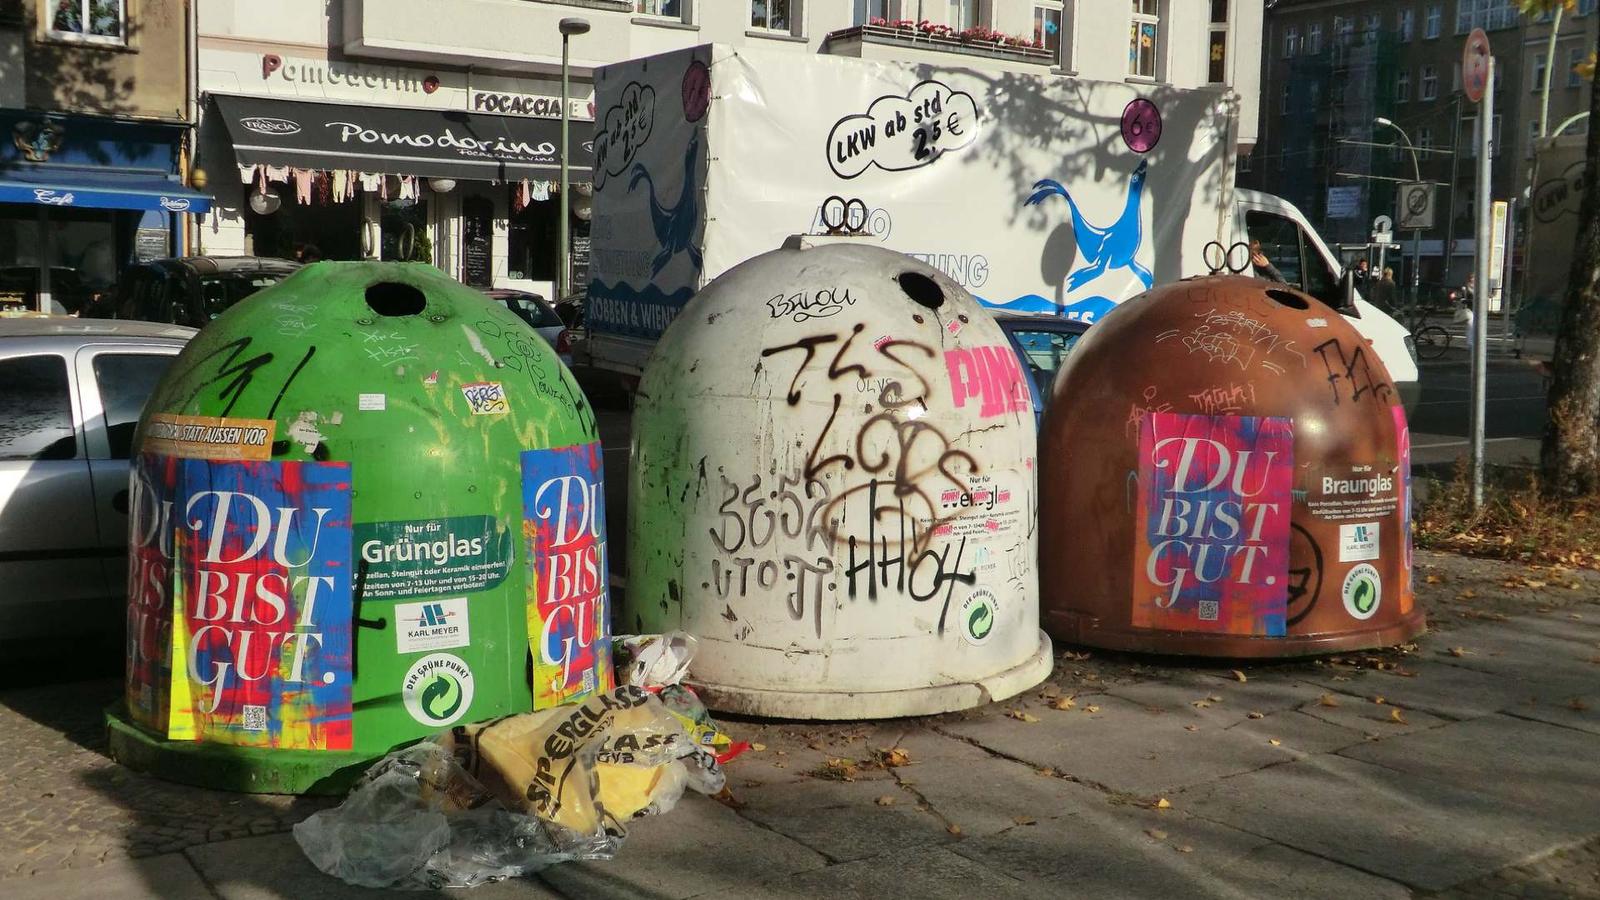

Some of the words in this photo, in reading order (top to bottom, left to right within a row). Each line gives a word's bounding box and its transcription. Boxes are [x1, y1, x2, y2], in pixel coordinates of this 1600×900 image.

[475, 93, 562, 117] FOCACCIA
[325, 121, 556, 155] Pomodorino
[837, 125, 876, 164] LKW
[885, 110, 906, 138] ab
[914, 90, 942, 123] std
[34, 189, 75, 205] Café
[204, 427, 242, 444] AUSSEN
[243, 428, 268, 445] VOR
[1152, 437, 1278, 497] DU
[1322, 473, 1393, 497] Braunglas
[535, 475, 603, 547] DU
[1154, 498, 1278, 542] BIST
[186, 491, 333, 568] DU
[405, 525, 424, 534] Nur
[426, 523, 441, 532] für
[361, 533, 483, 565] Grünglas
[391, 569, 423, 579] Steingut
[424, 568, 441, 576] oder
[442, 565, 470, 573] Keramik
[424, 578, 437, 586] Uhr
[438, 577, 452, 585] und
[544, 541, 606, 604] BIST
[1146, 540, 1277, 609] GUT.
[193, 570, 335, 627] BIST
[398, 587, 412, 595] und
[414, 584, 451, 594] Feiertagen
[408, 628, 430, 638] KARL
[432, 626, 459, 636] MEYER
[188, 625, 336, 713] GUT.
[406, 674, 419, 691] DER
[417, 660, 444, 678] GRÜNE
[445, 660, 469, 679] PUNKT
